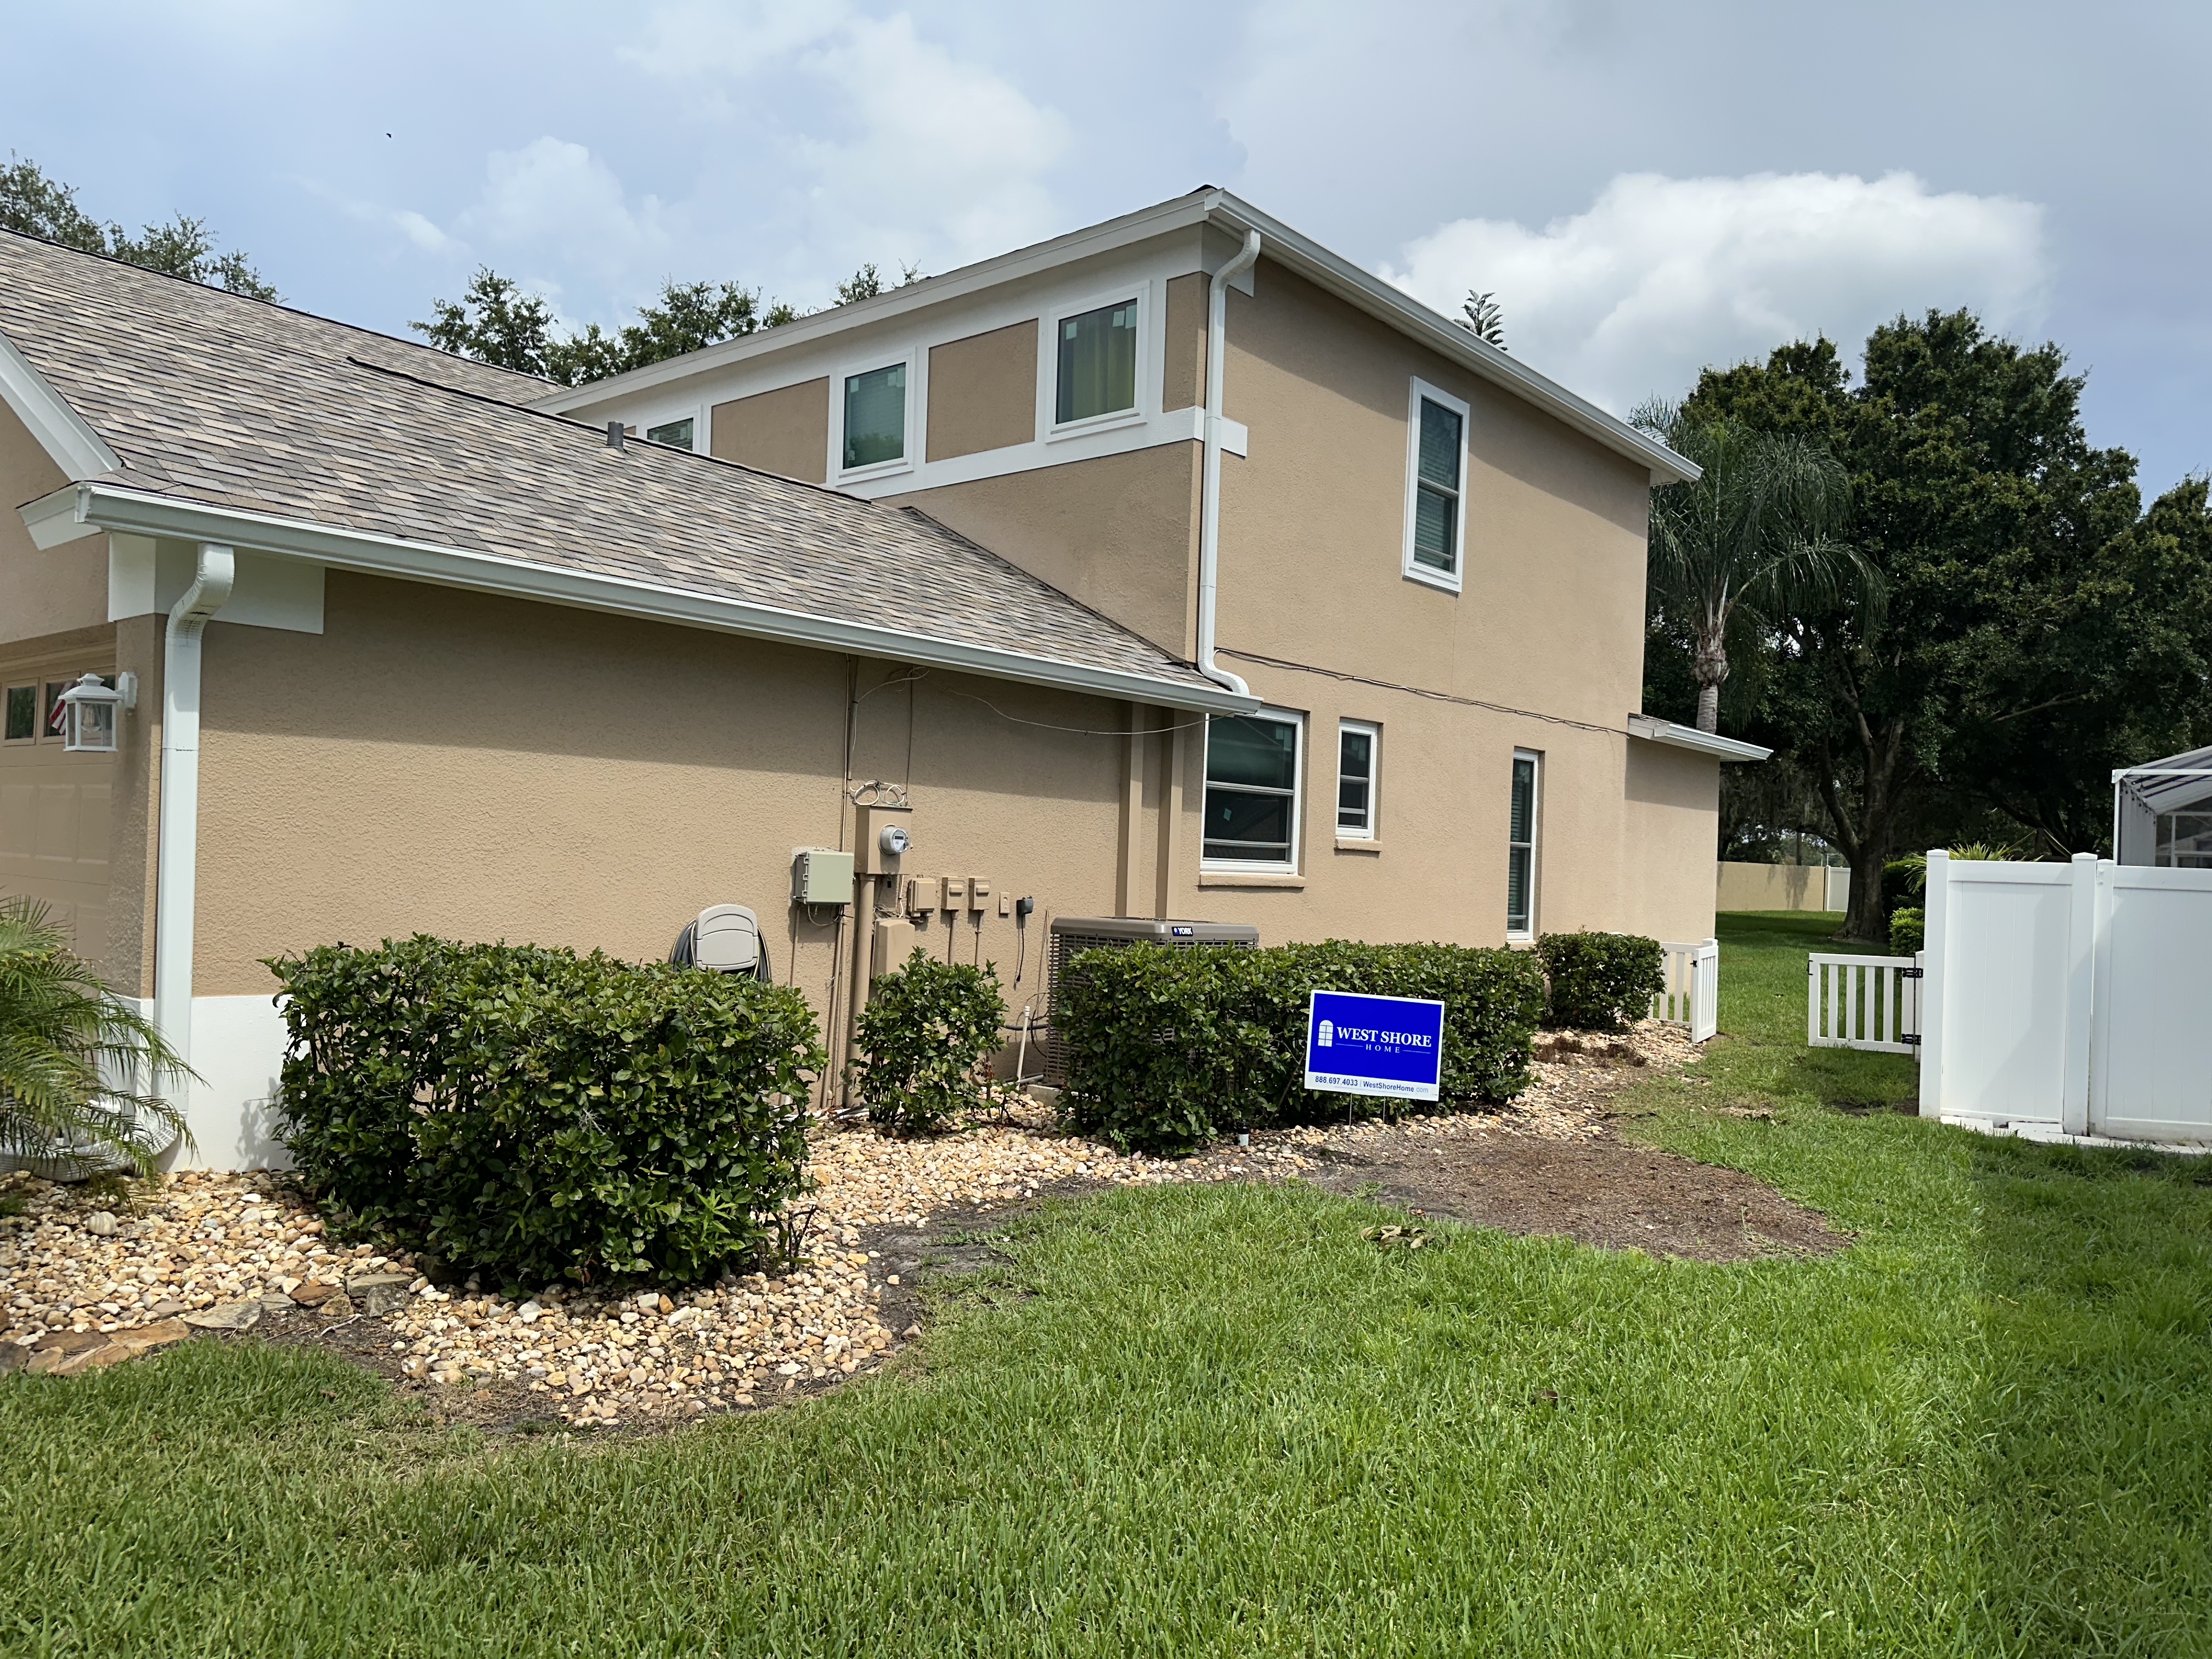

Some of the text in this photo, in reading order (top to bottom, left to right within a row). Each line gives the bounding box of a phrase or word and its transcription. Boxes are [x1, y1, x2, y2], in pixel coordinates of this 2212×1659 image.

[1336, 1026, 1432, 1047] WEST SHORE
[1365, 1043, 1400, 1053] HOME
[1315, 1075, 1358, 1087] 888.697.4033
[1363, 1081, 1429, 1093] WestShoreHome.com
